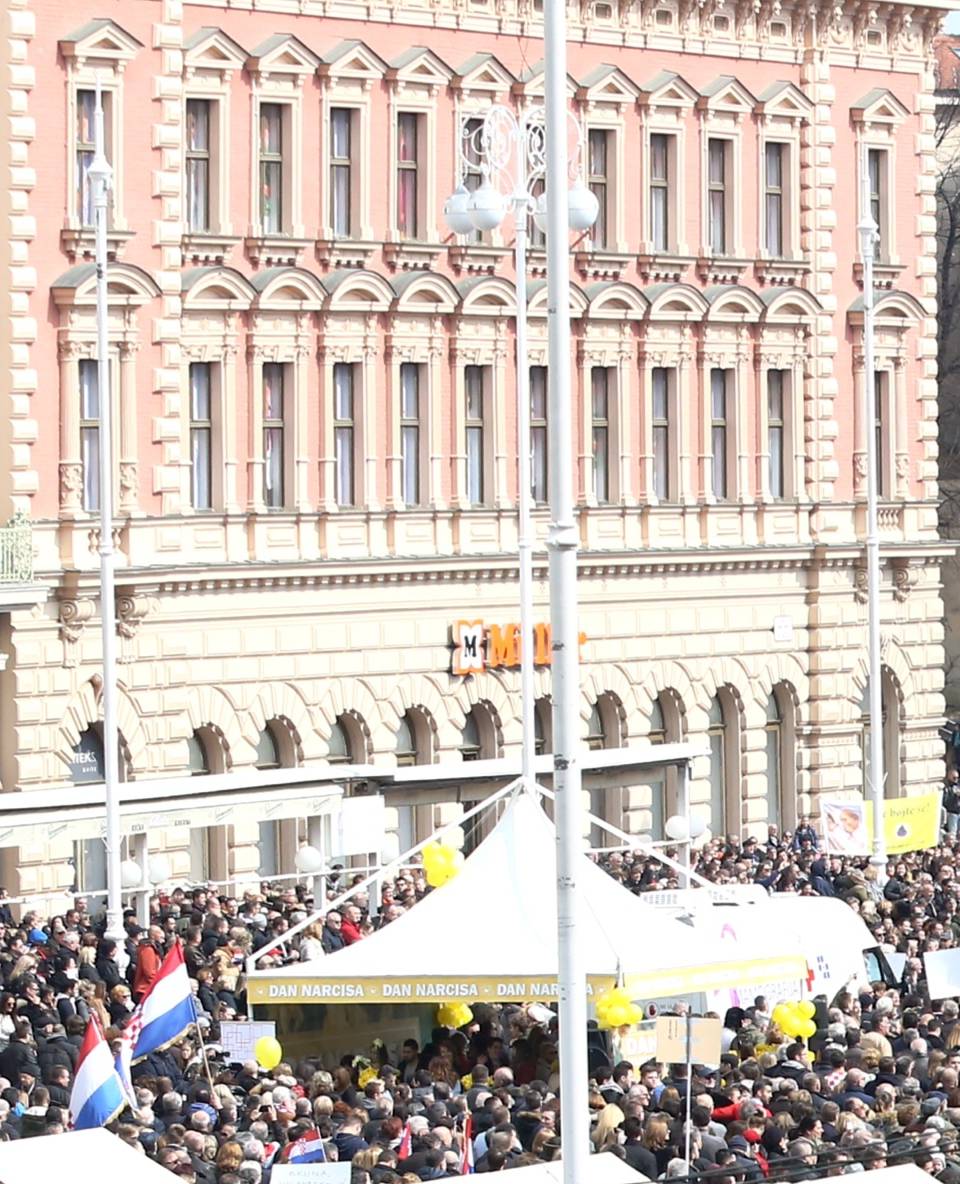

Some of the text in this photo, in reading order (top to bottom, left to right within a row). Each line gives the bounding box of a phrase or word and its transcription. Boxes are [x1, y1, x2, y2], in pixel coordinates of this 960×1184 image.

[269, 984, 365, 997] DAN NARCISA
[383, 983, 479, 997] DAN NARCISA
[497, 983, 594, 996] DAN NARA
